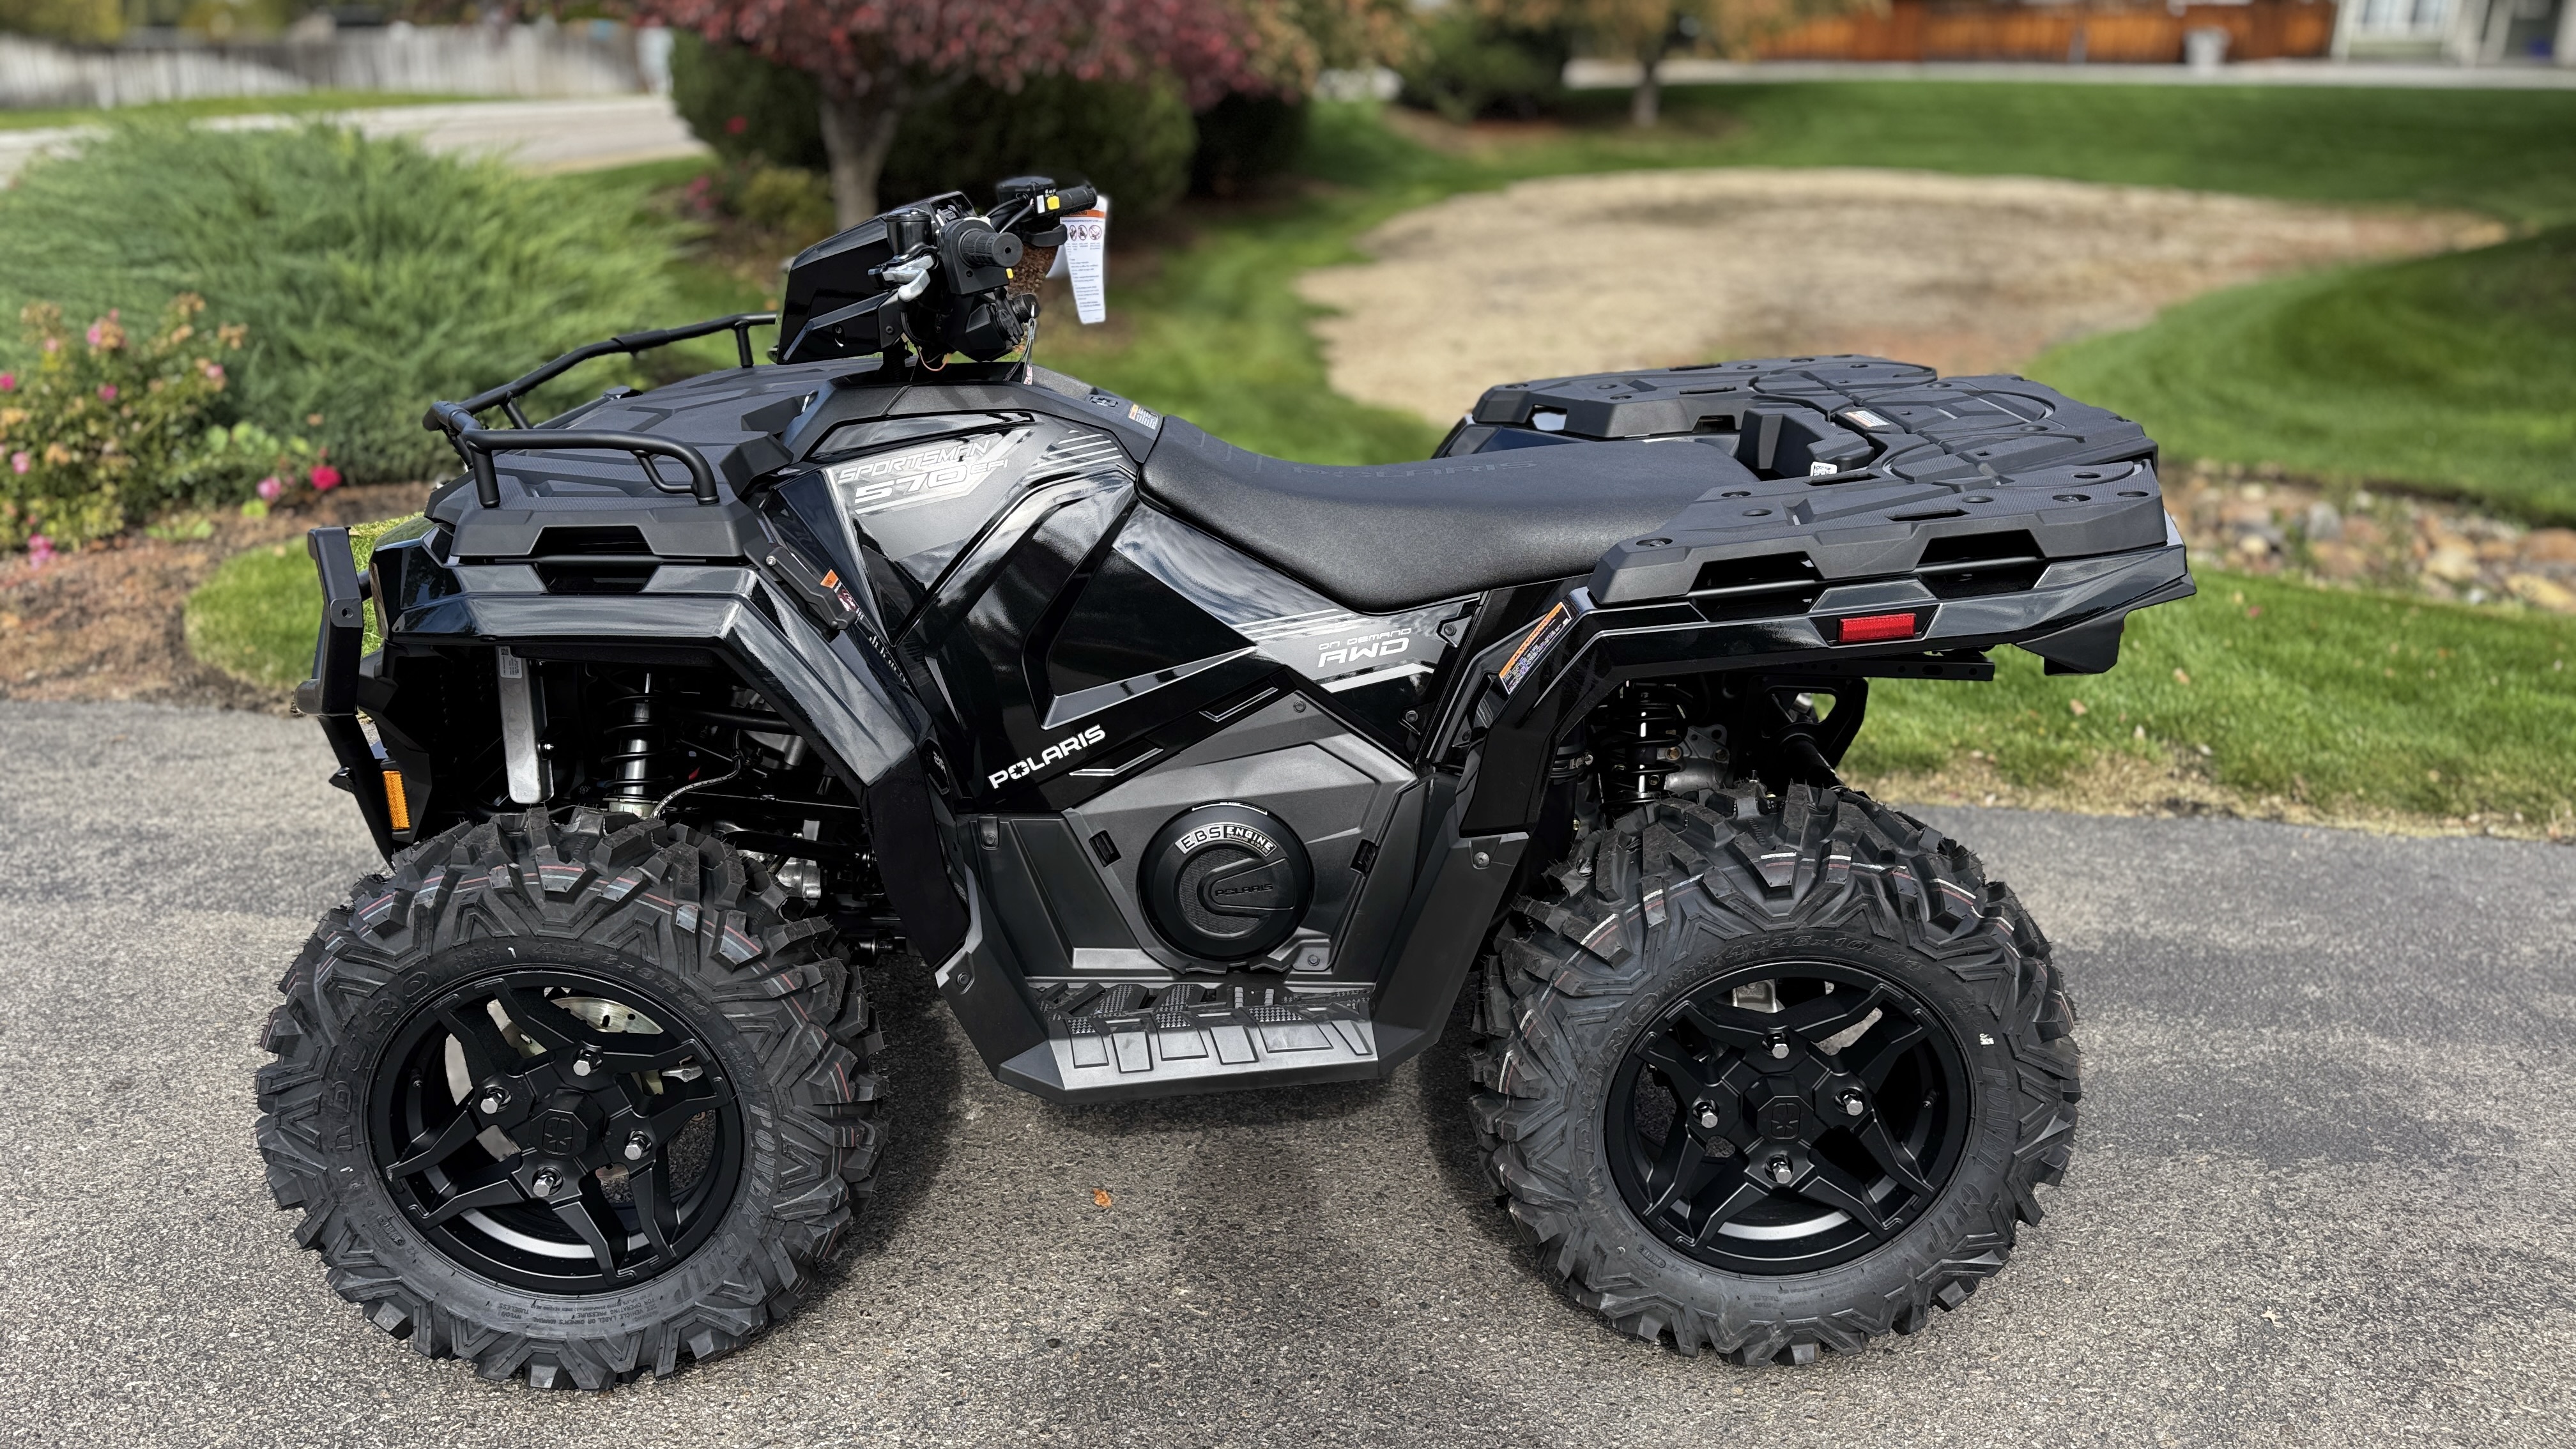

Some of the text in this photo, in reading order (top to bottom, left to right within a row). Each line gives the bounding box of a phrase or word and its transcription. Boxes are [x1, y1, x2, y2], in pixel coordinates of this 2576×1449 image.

[838, 440, 990, 484] SPORTSMAN
[854, 459, 1009, 504] 570 EFI
[1318, 627, 1411, 650] ON DEMAND
[1317, 637, 1409, 668] AWD
[988, 723, 1106, 790] POLARIS
[1181, 825, 1274, 851] EBS ENGINE
[1215, 883, 1273, 897] POLARIS
[498, 1303, 530, 1315] TUBELESS
[610, 1302, 642, 1315] OPERATING
[619, 1308, 644, 1320] VEHICLE
